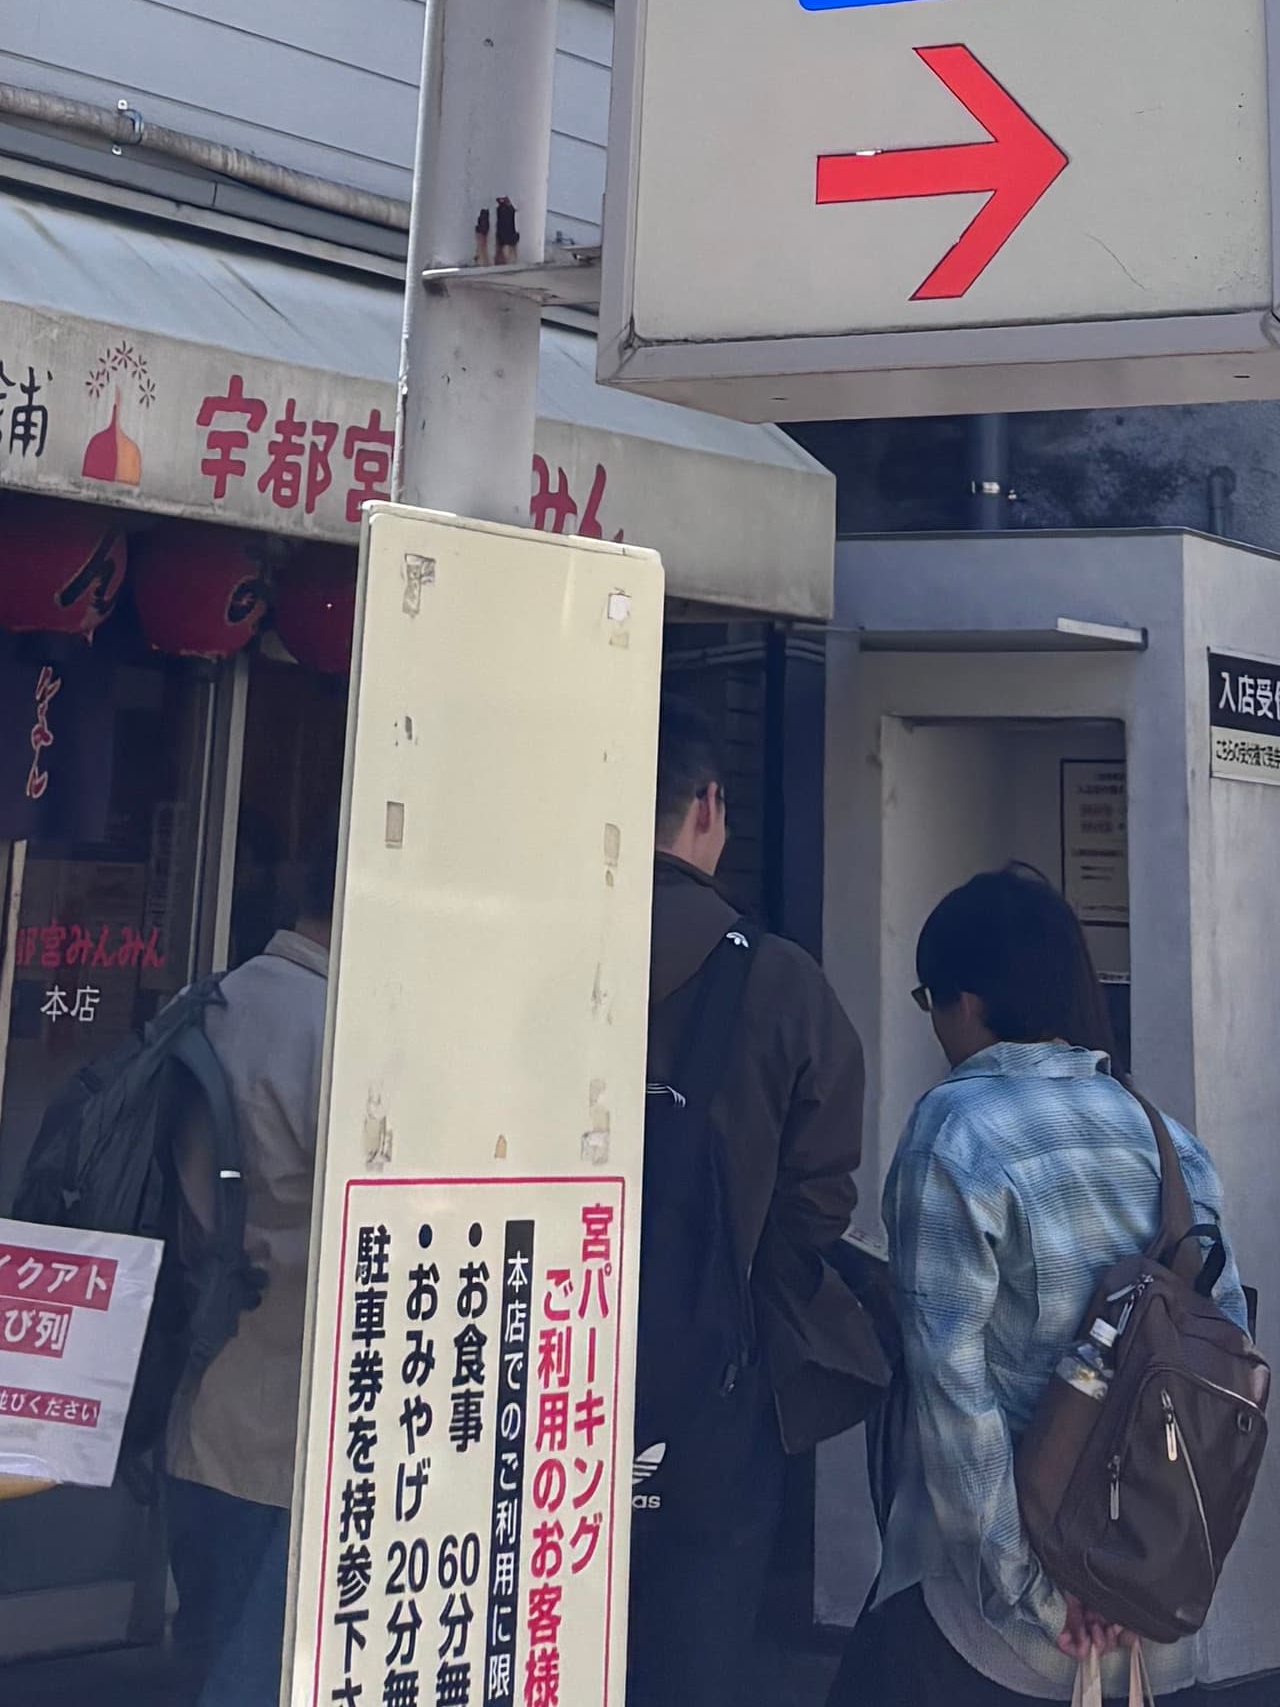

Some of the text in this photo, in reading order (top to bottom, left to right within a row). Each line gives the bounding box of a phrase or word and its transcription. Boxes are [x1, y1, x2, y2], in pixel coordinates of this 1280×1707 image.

[40, 984, 101, 1023] 本店
[448, 1261, 490, 1453] お食事
[488, 1251, 529, 1700] 本店でのご利用に限
[523, 1268, 574, 1707] ご利用のお客様
[569, 1203, 613, 1576] 宮パーキング
